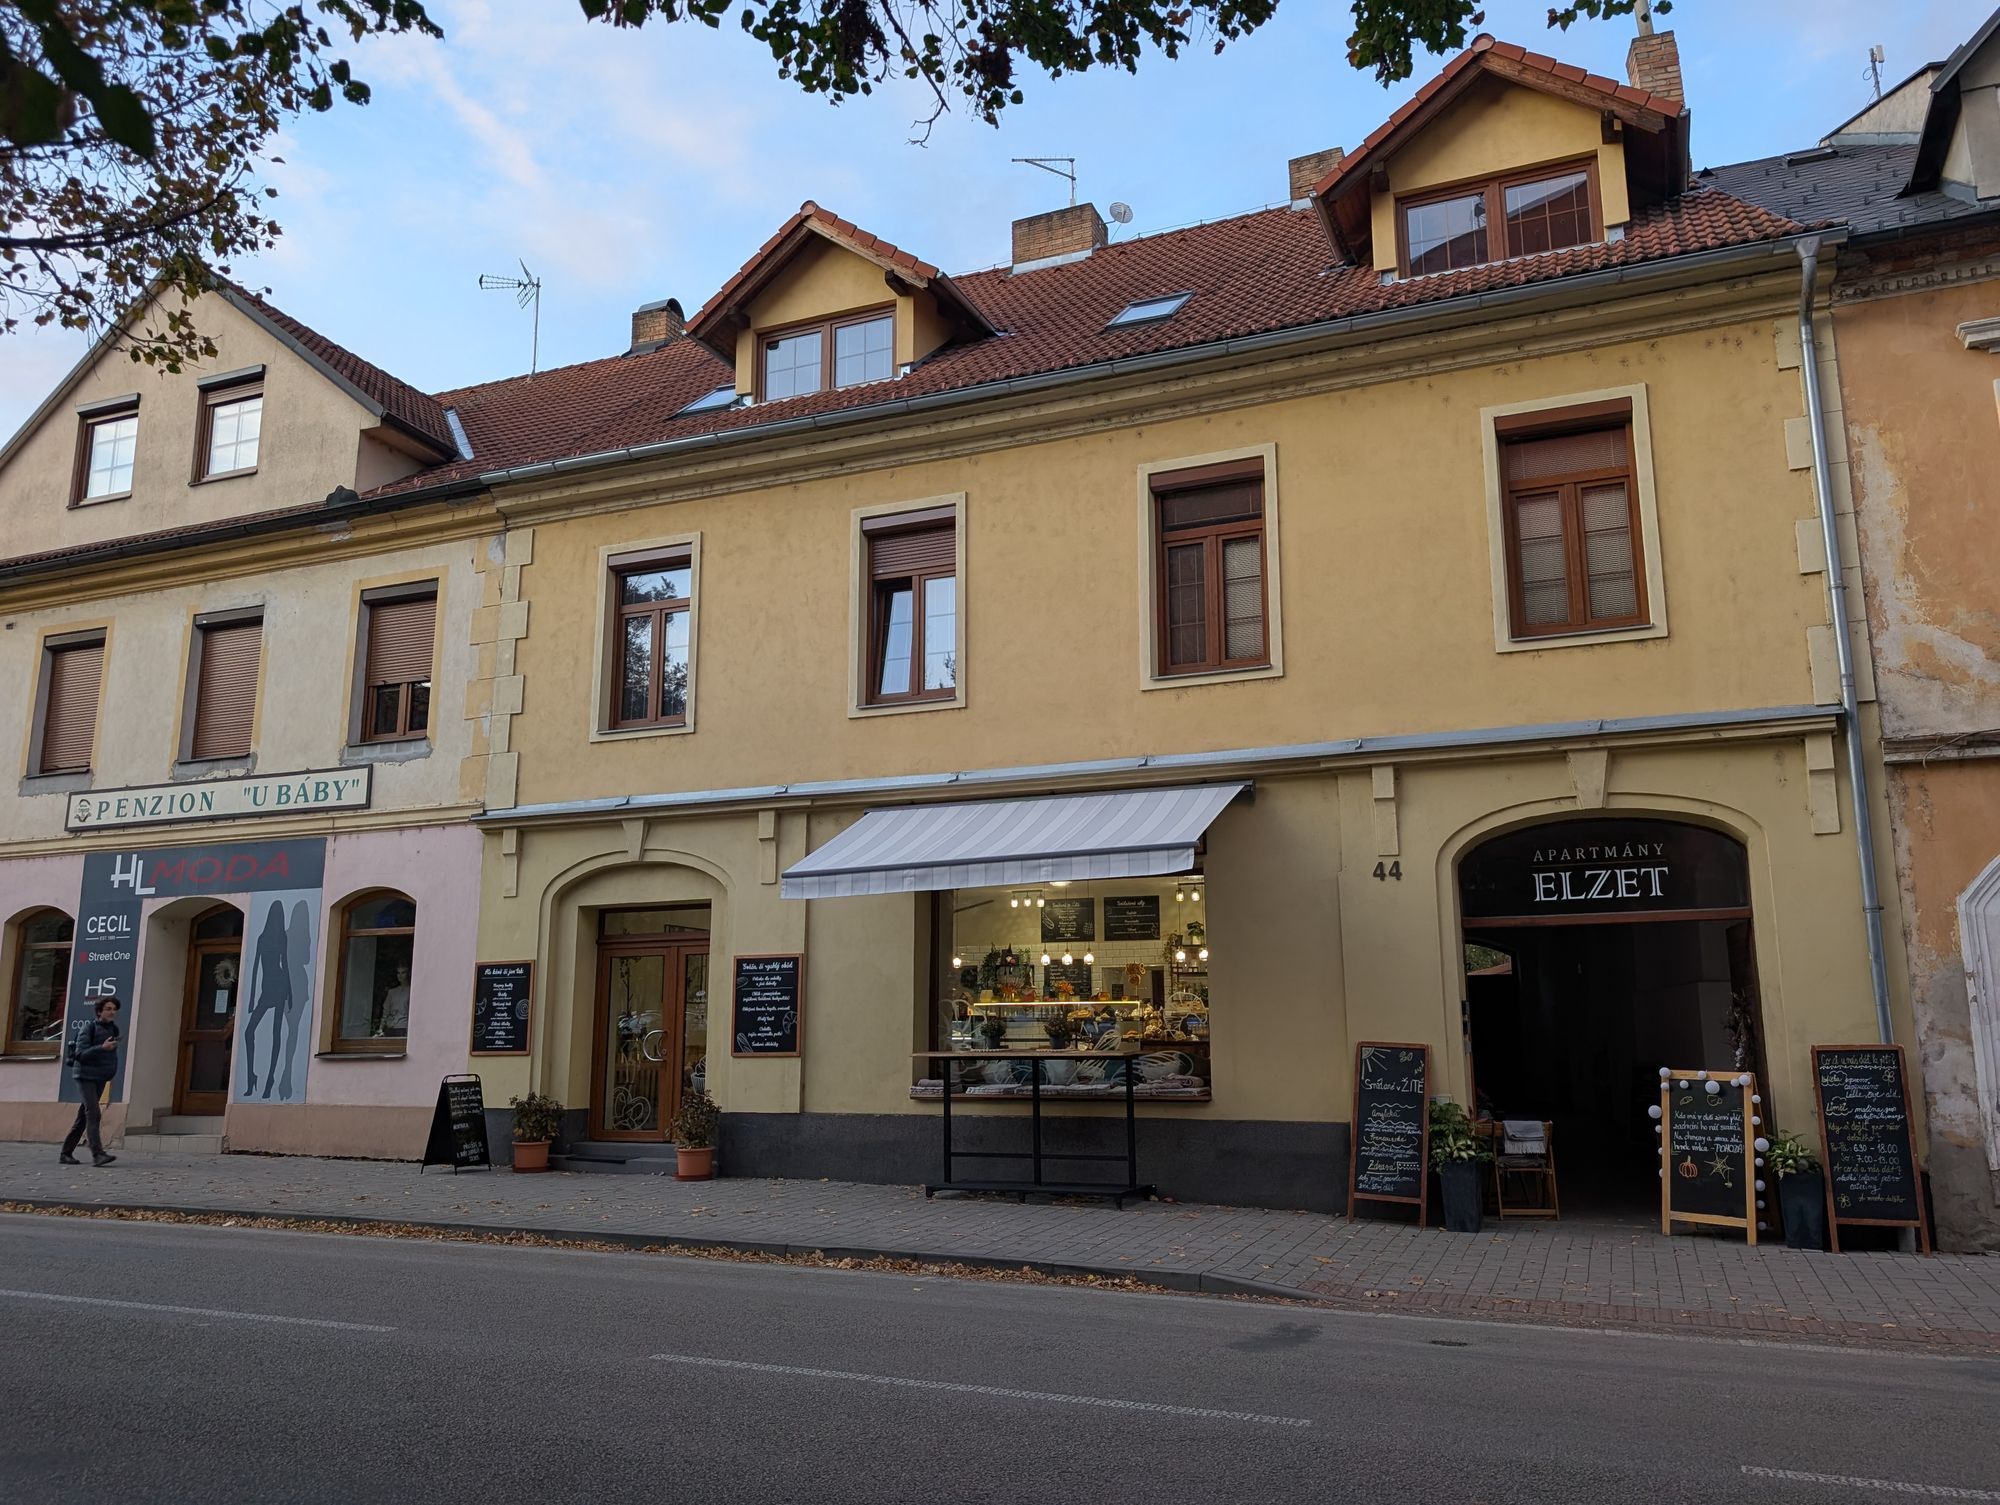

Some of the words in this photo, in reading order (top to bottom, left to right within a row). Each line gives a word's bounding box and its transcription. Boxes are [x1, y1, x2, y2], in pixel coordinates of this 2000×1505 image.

[96, 790, 215, 821] PENZION
[243, 785, 269, 807] "U
[275, 777, 359, 806] BÁBY"
[1532, 841, 1665, 862] APARTMÁNY
[148, 851, 289, 886] MODA
[1372, 860, 1402, 881] 44
[1531, 866, 1669, 902] ELZET
[87, 914, 132, 934] CECIL
[88, 950, 113, 962] Street
[113, 951, 131, 961] One
[84, 977, 117, 997] HS
[1877, 1143, 1898, 1154] 18.00
